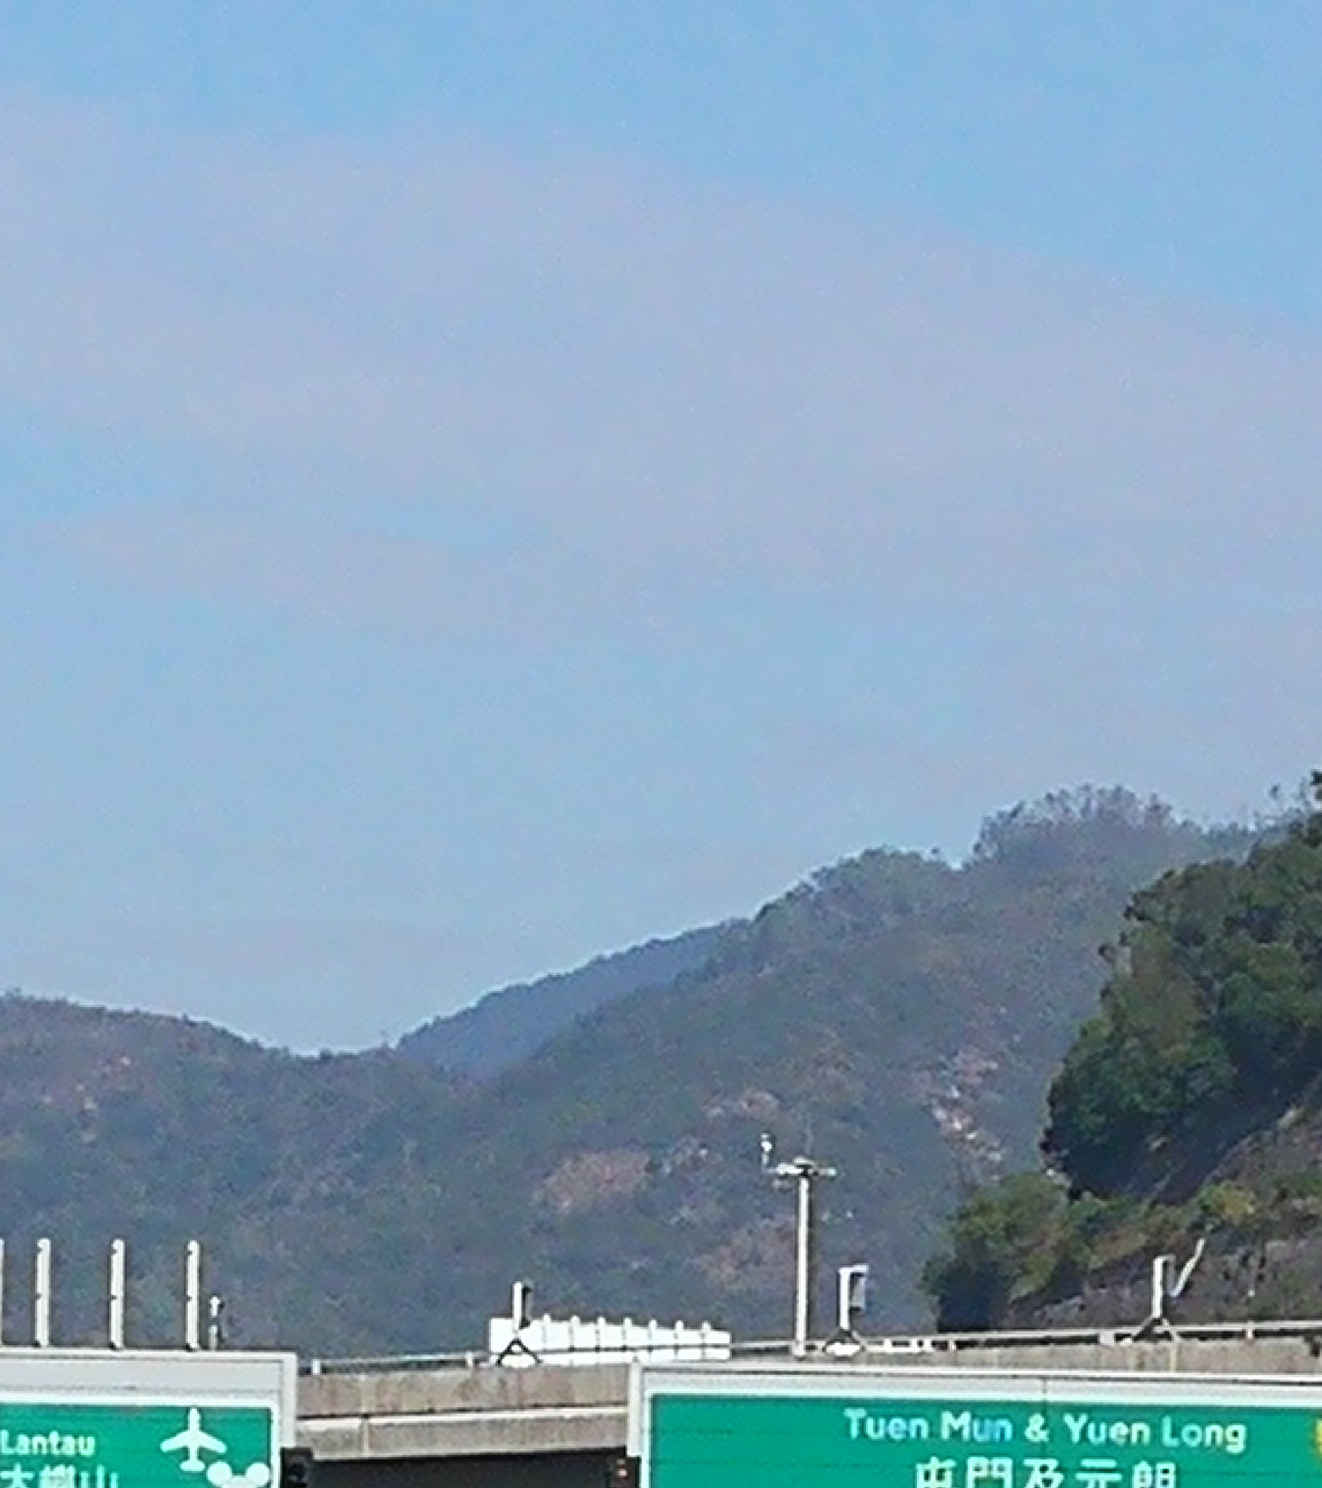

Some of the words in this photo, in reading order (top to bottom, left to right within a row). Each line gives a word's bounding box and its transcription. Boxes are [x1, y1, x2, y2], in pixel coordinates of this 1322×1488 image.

[843, 1407, 929, 1440] Tuen
[939, 1410, 1013, 1442] Mun
[1024, 1413, 1050, 1444] &
[1063, 1414, 1150, 1446] Yuen
[1161, 1416, 1246, 1454] Long
